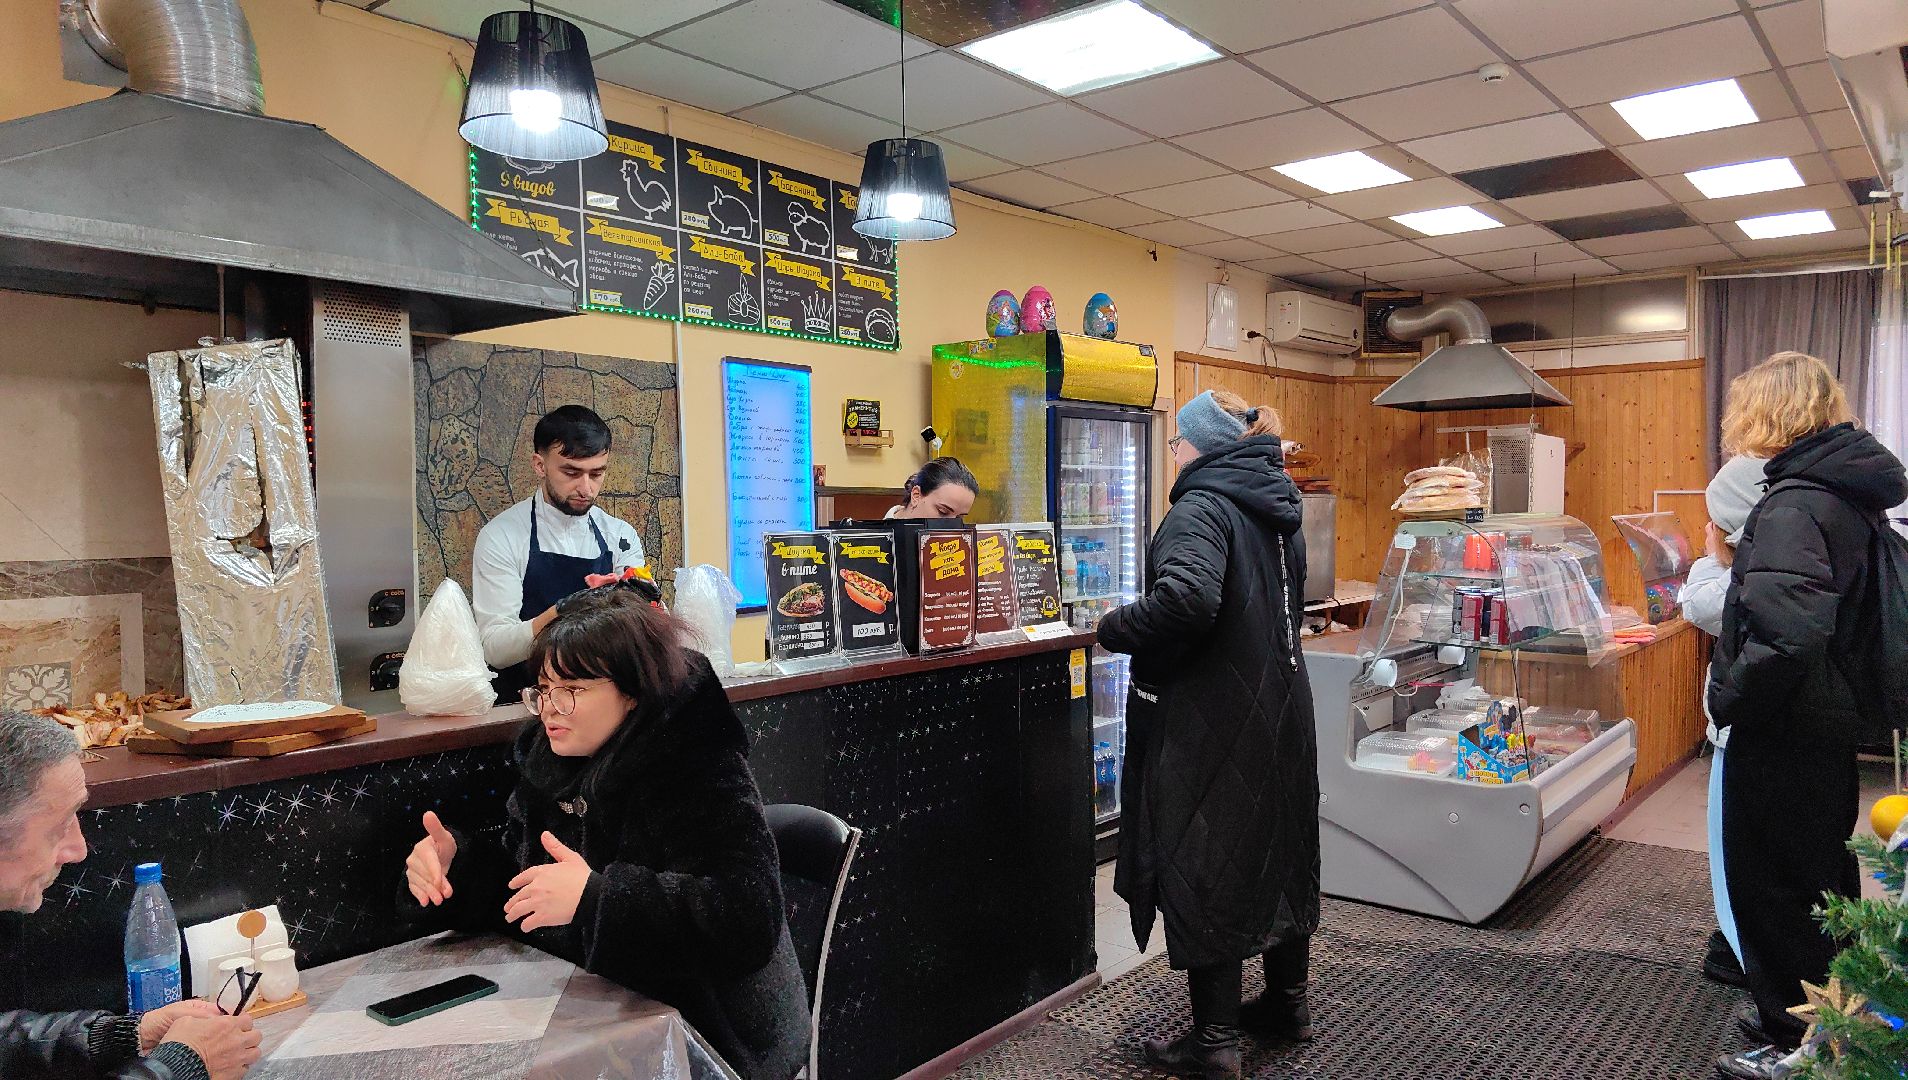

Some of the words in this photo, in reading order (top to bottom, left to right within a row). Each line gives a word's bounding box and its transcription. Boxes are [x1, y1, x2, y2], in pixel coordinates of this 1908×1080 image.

[703, 160, 737, 178] Свинина
[513, 174, 557, 198] видов
[780, 181, 816, 198] Баранина
